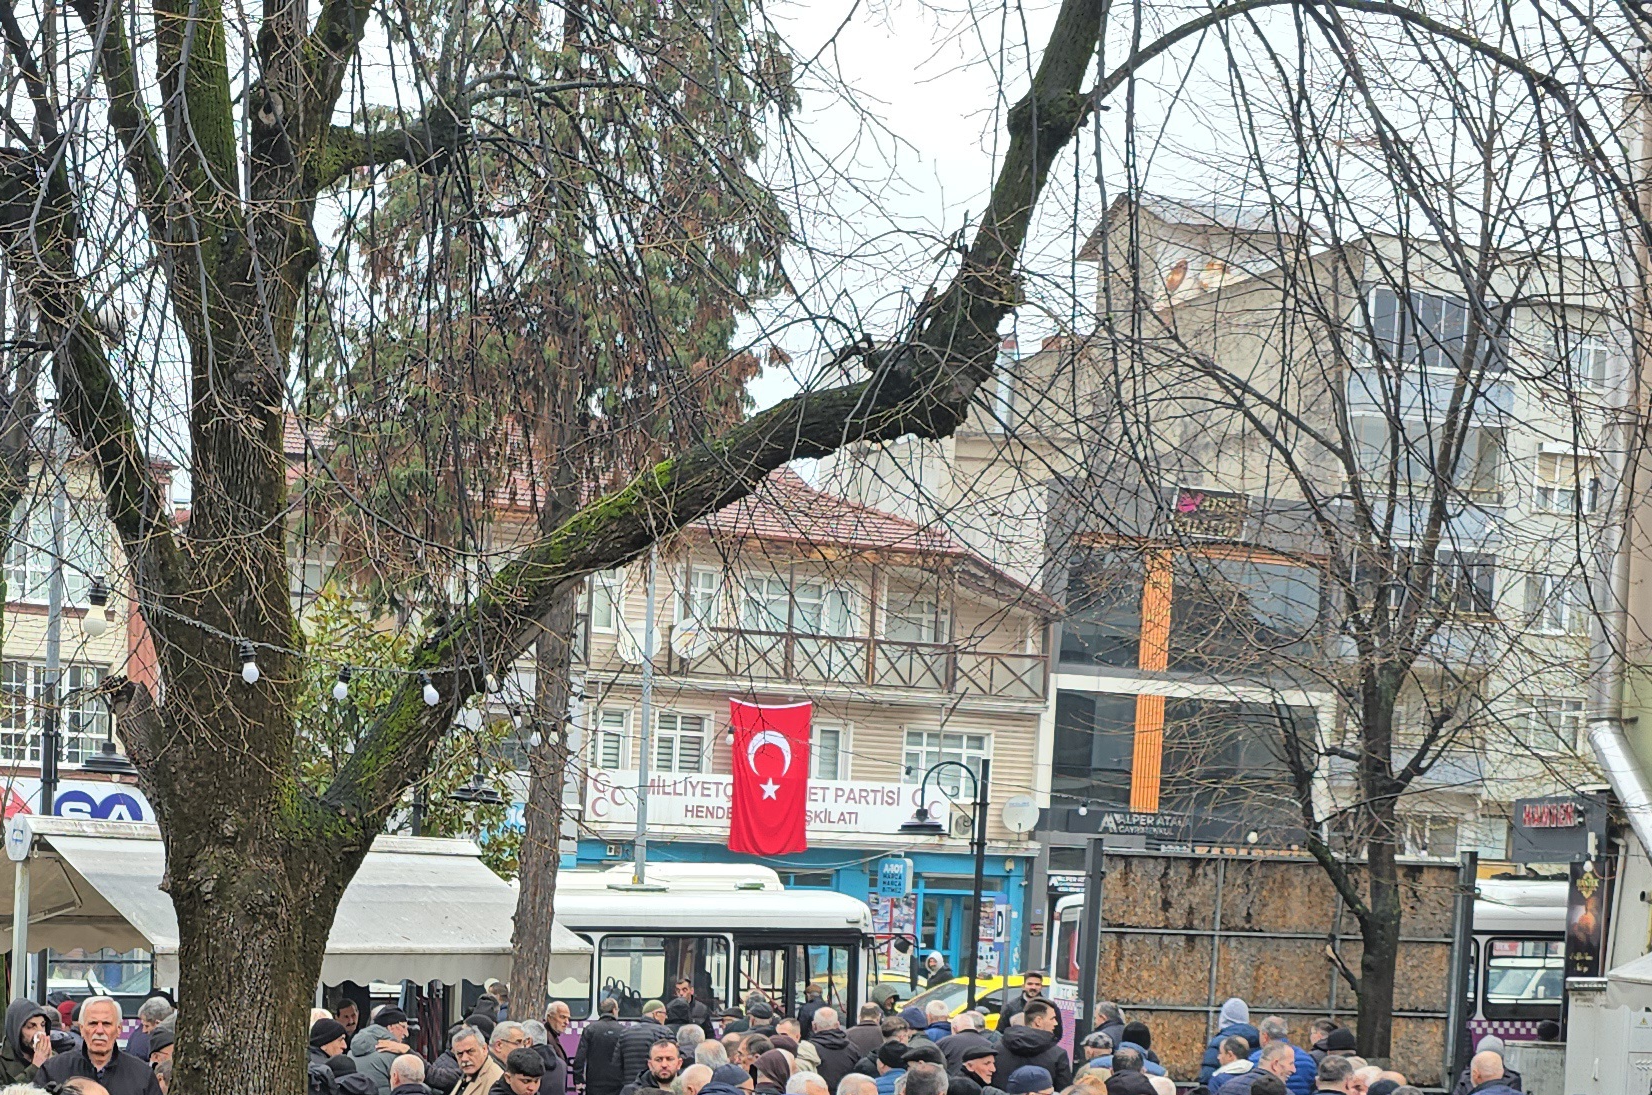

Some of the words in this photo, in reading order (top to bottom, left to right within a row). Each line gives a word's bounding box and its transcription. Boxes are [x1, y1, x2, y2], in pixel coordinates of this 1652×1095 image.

[646, 774, 733, 803] MİLLİYETÇ
[808, 786, 830, 803] ET
[834, 786, 901, 807] PARTİSİ
[684, 804, 733, 820] HENDE
[805, 808, 859, 826] ŞKİLATI
